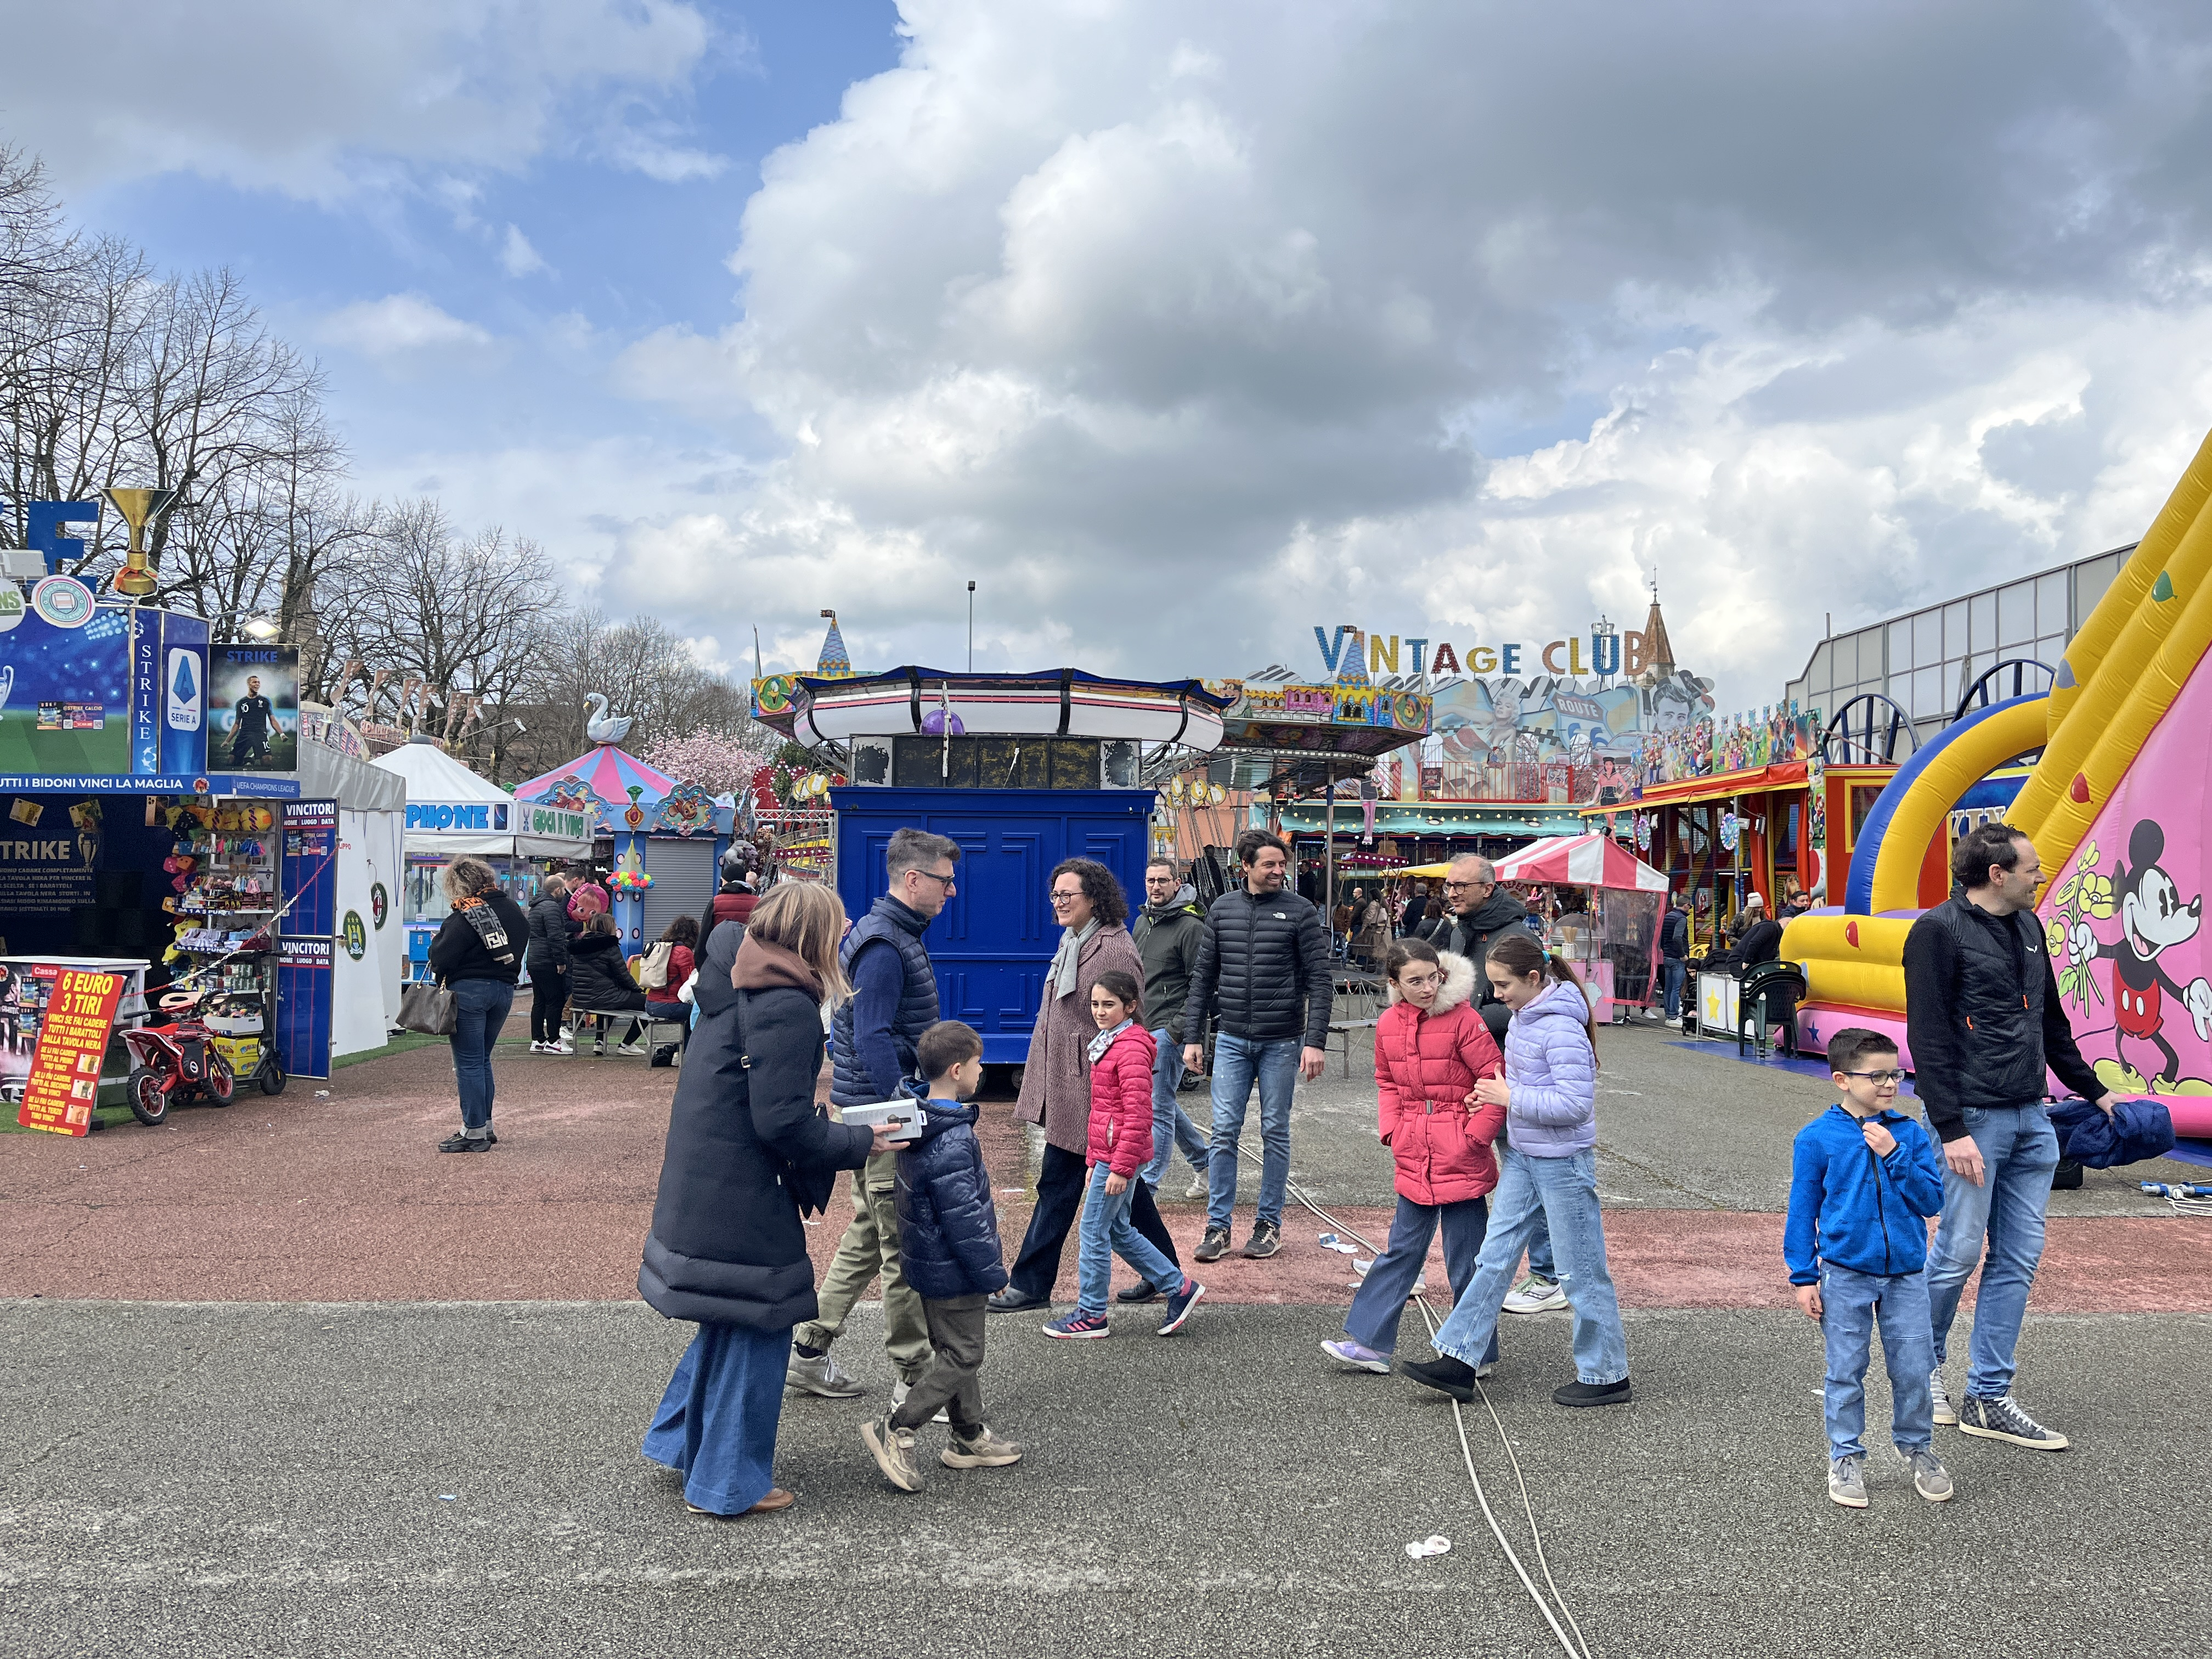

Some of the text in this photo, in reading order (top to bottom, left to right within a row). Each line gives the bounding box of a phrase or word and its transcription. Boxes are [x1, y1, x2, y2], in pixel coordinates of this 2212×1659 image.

[227, 651, 278, 663] STRIKE
[1542, 630, 1647, 675] CLUB
[139, 645, 153, 740] STRIKE
[1557, 698, 1599, 718] ROUTE
[171, 713, 196, 724] SERIE A
[32, 778, 76, 788] BIDONI
[79, 778, 112, 788] VINCI
[116, 779, 132, 788] LA
[135, 779, 183, 789] MAGLIA
[250, 783, 277, 791] CHAMPIONS
[278, 785, 295, 793] LEAGUE
[286, 803, 335, 816] VINCITORI
[405, 804, 489, 829] PHONE
[533, 809, 584, 837] GIOCA E VINCI
[0, 840, 71, 860] TRIKE
[282, 942, 329, 955] VINCITORI
[34, 967, 58, 975] Cassa
[62, 972, 114, 995] 6 EURO
[61, 993, 103, 1015] 3 TIRI
[48, 1013, 64, 1023] VINCI
[65, 1015, 73, 1025] SE
[73, 1016, 83, 1026] FAI
[83, 1018, 108, 1029] CADERE
[48, 1024, 65, 1034] TUTTI
[69, 1026, 102, 1039] BARATTOLI
[42, 1034, 101, 1050] DALLA TAVOLA NERA
[48, 1107, 63, 1115] TERZO
